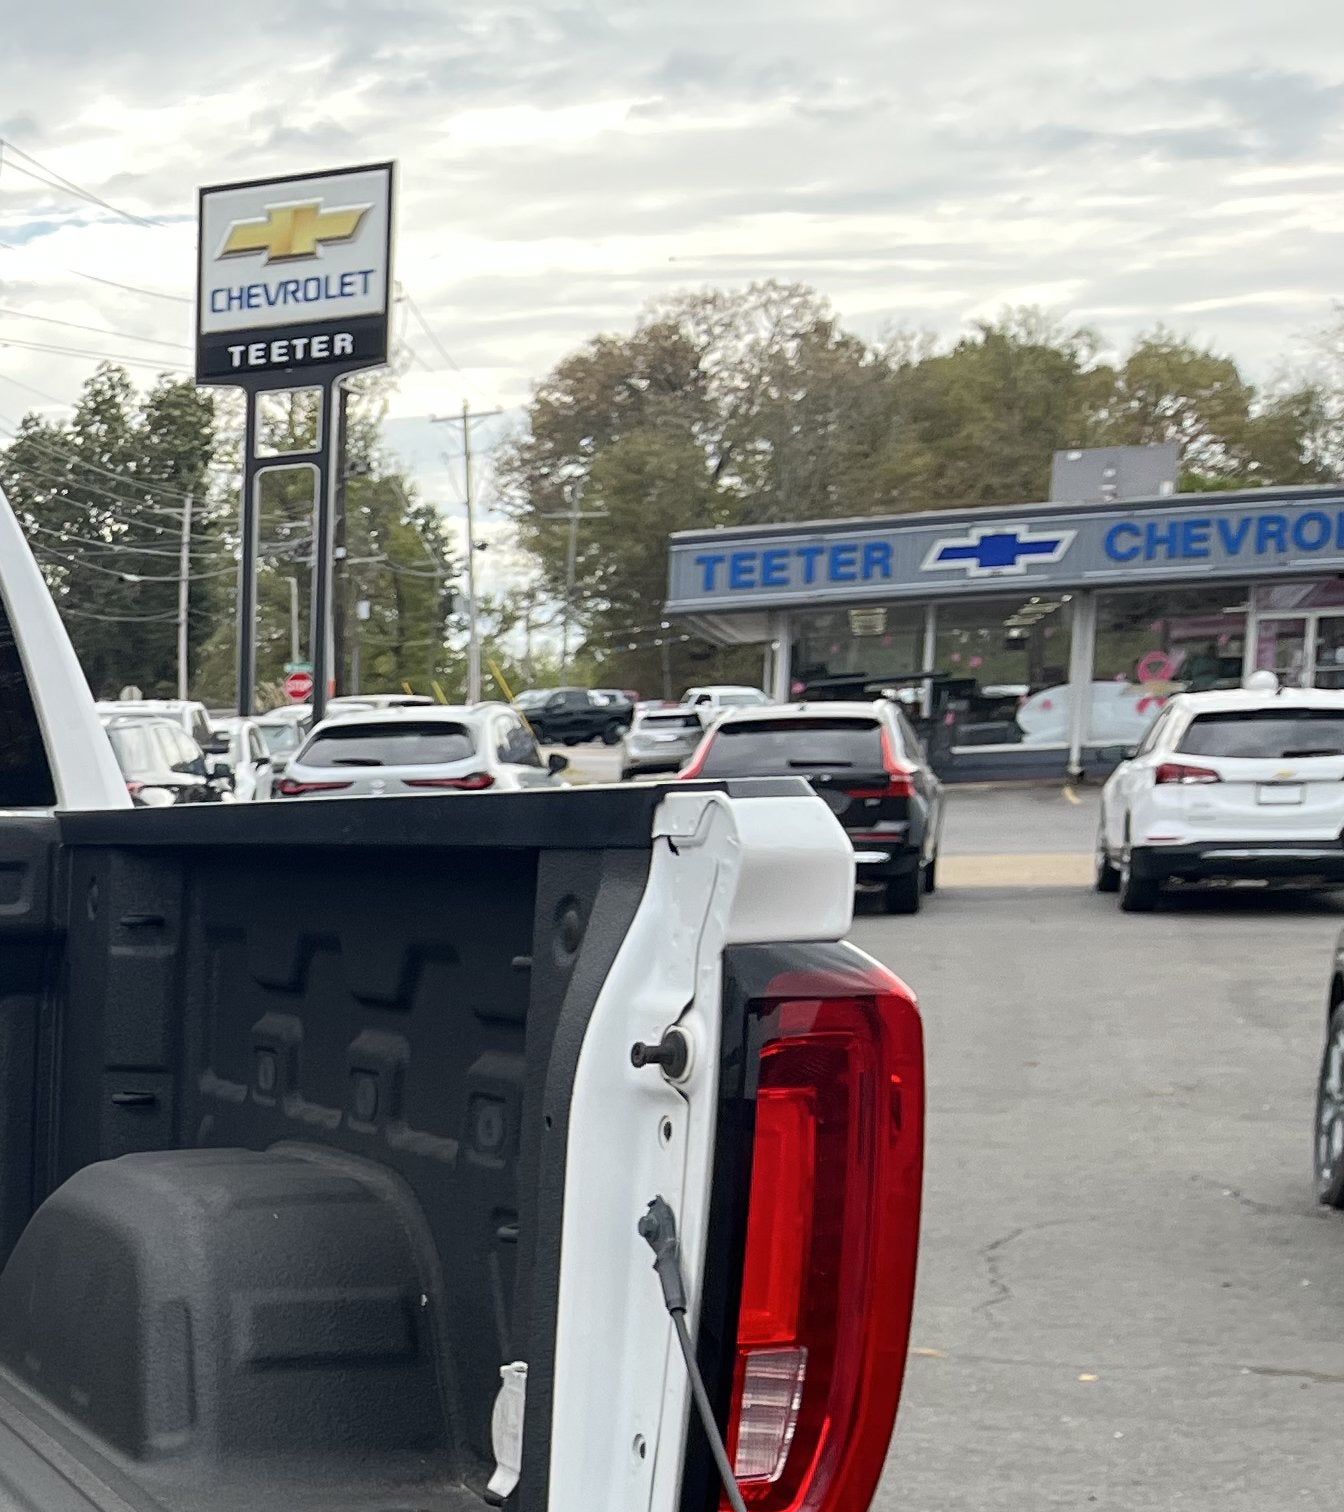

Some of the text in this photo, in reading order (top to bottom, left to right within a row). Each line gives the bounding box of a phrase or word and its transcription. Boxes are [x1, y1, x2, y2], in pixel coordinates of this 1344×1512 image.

[211, 269, 374, 313] CHEVROLET
[227, 333, 354, 368] TEETER
[694, 541, 894, 592] TEETER
